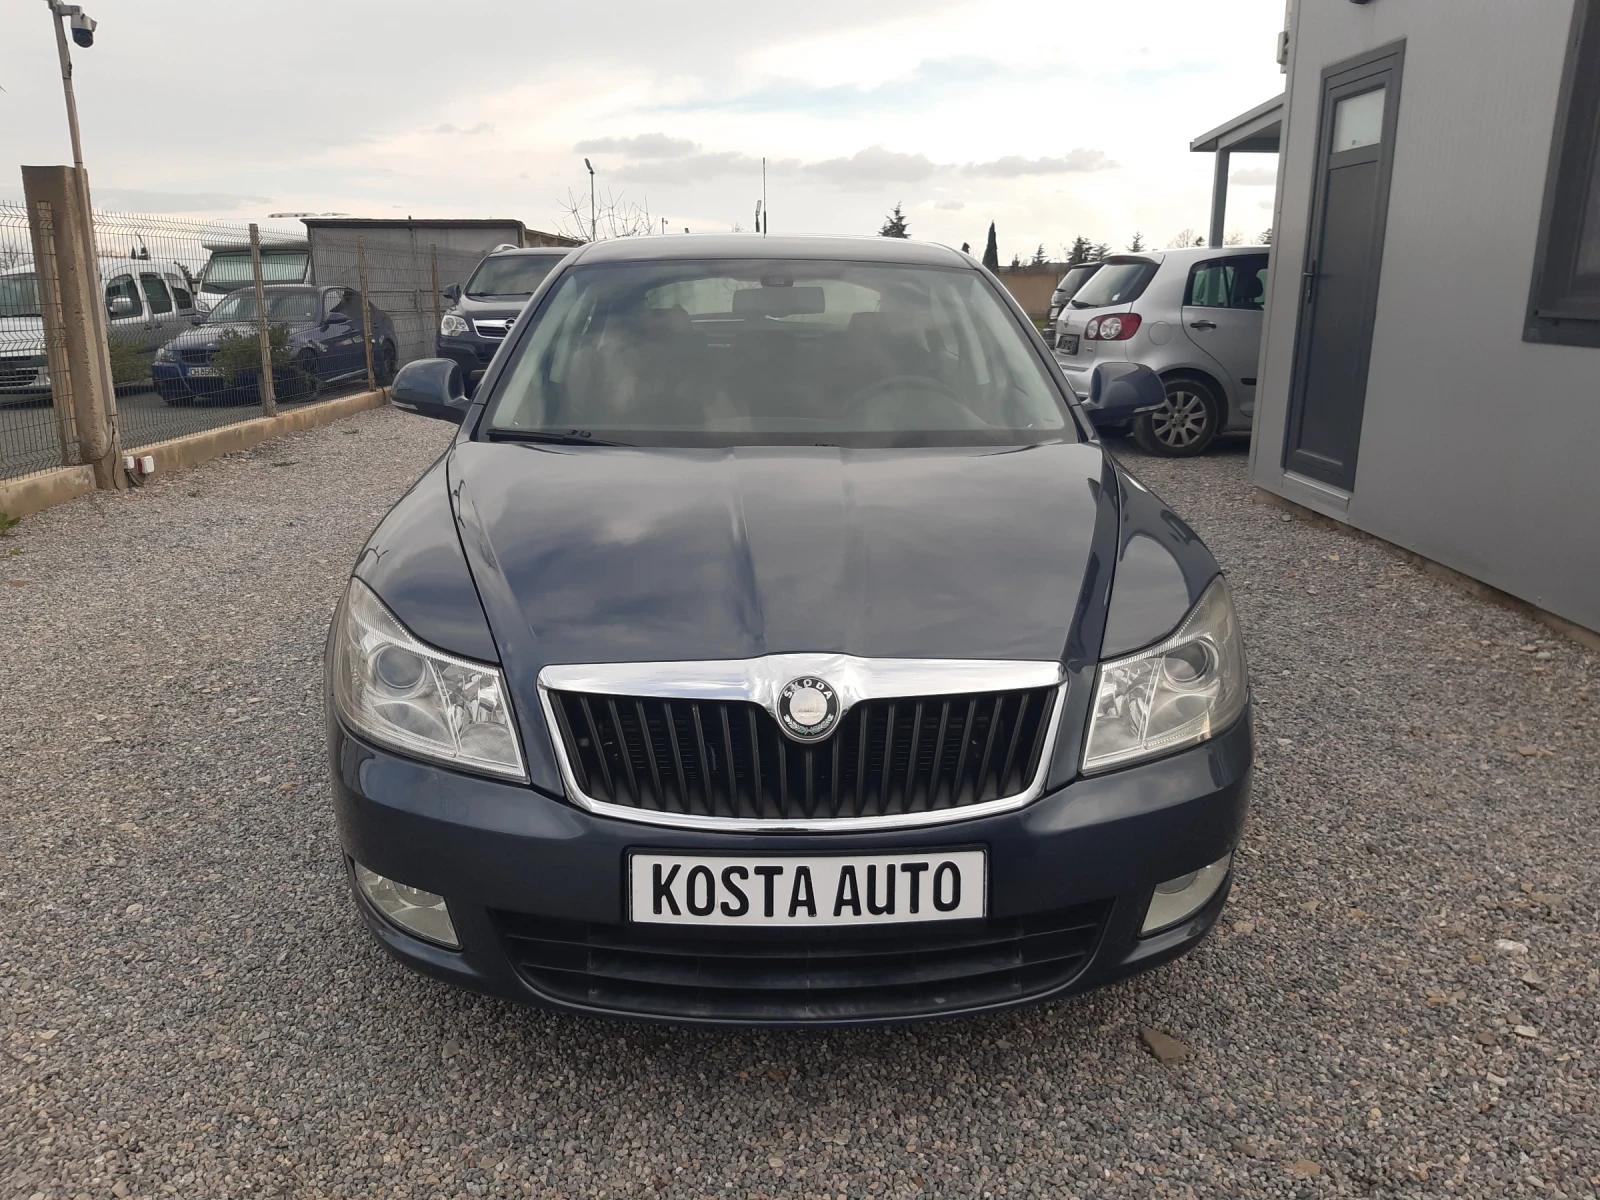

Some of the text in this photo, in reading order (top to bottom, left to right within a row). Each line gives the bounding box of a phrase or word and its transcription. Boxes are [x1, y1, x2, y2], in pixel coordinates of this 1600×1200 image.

[783, 679, 833, 700] SKODA
[652, 861, 962, 917] KOSTA AUTO
